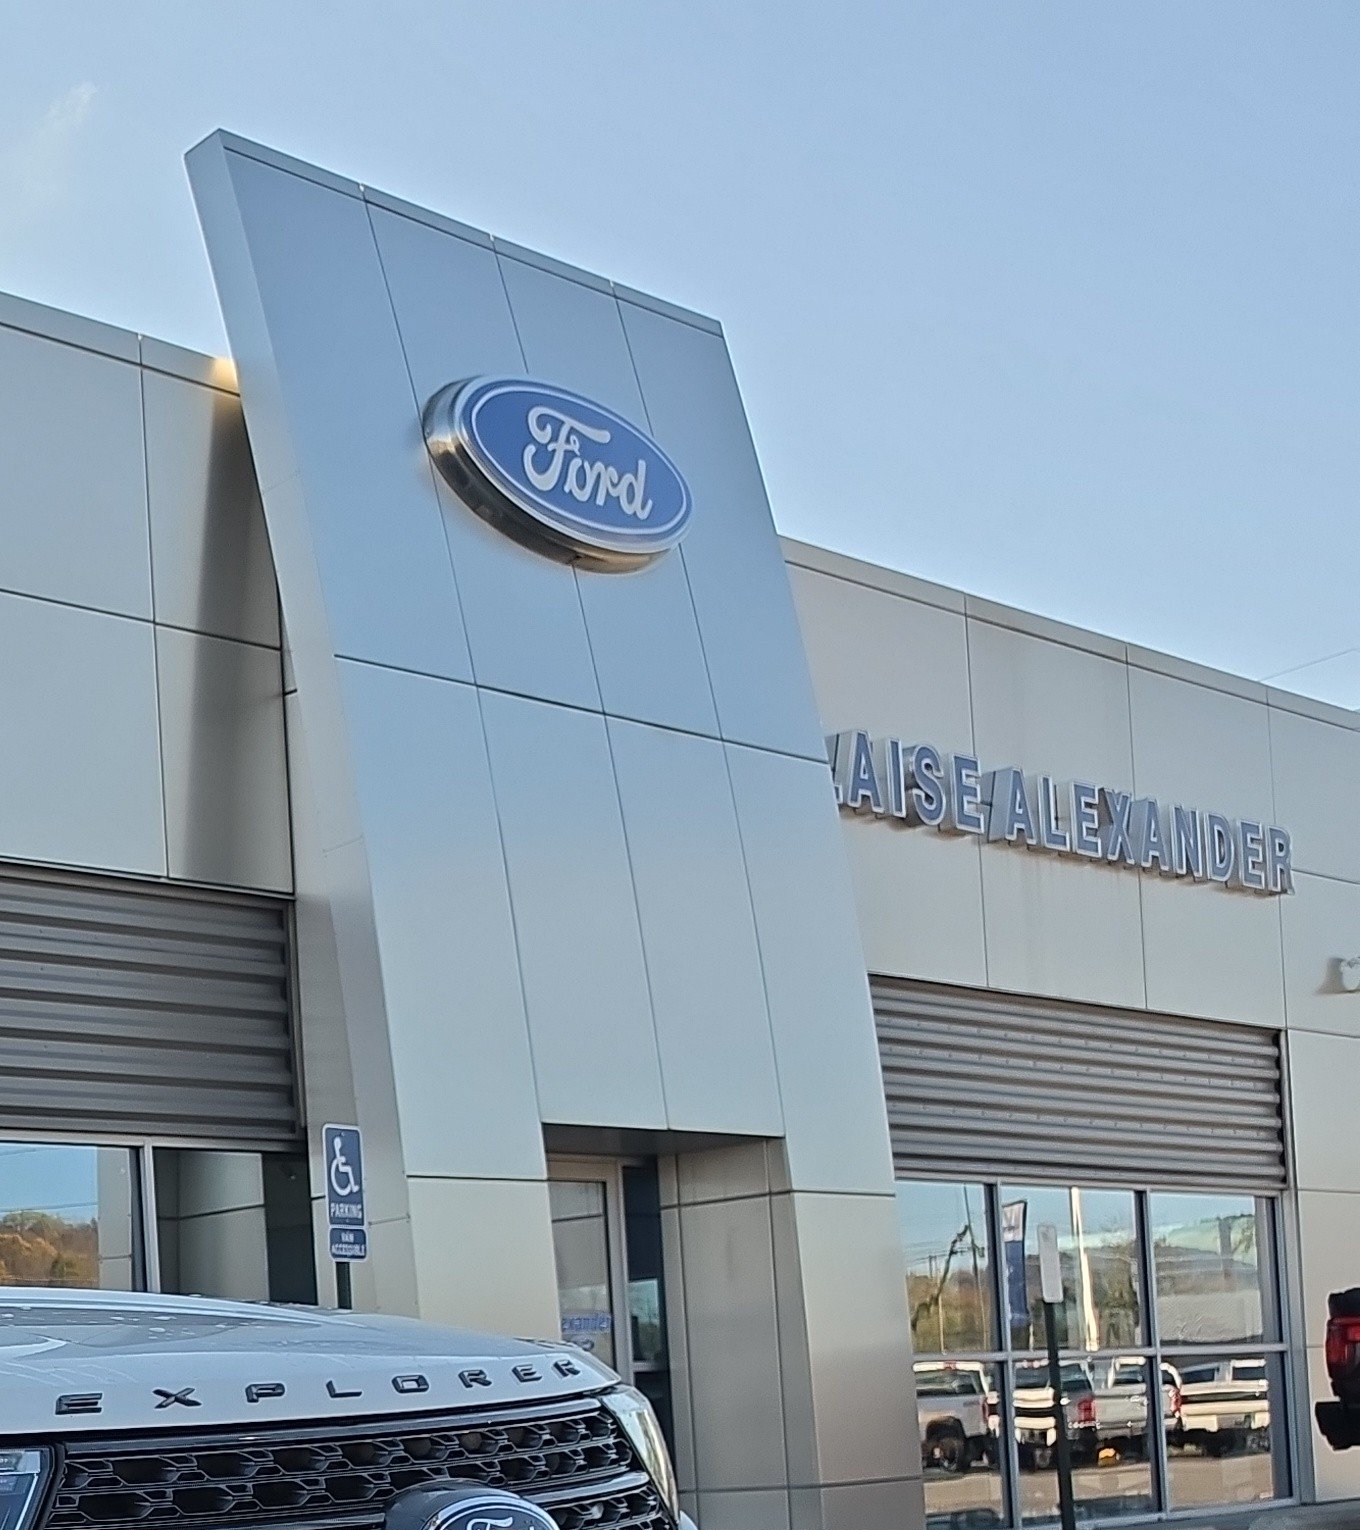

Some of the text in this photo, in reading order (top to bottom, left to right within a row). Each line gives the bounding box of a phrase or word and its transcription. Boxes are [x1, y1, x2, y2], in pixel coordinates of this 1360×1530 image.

[522, 405, 654, 520] Ford
[832, 730, 1295, 895] AISE ALEXANDER
[330, 1202, 362, 1219] PARKING
[55, 1358, 582, 1416] EXPLORER
